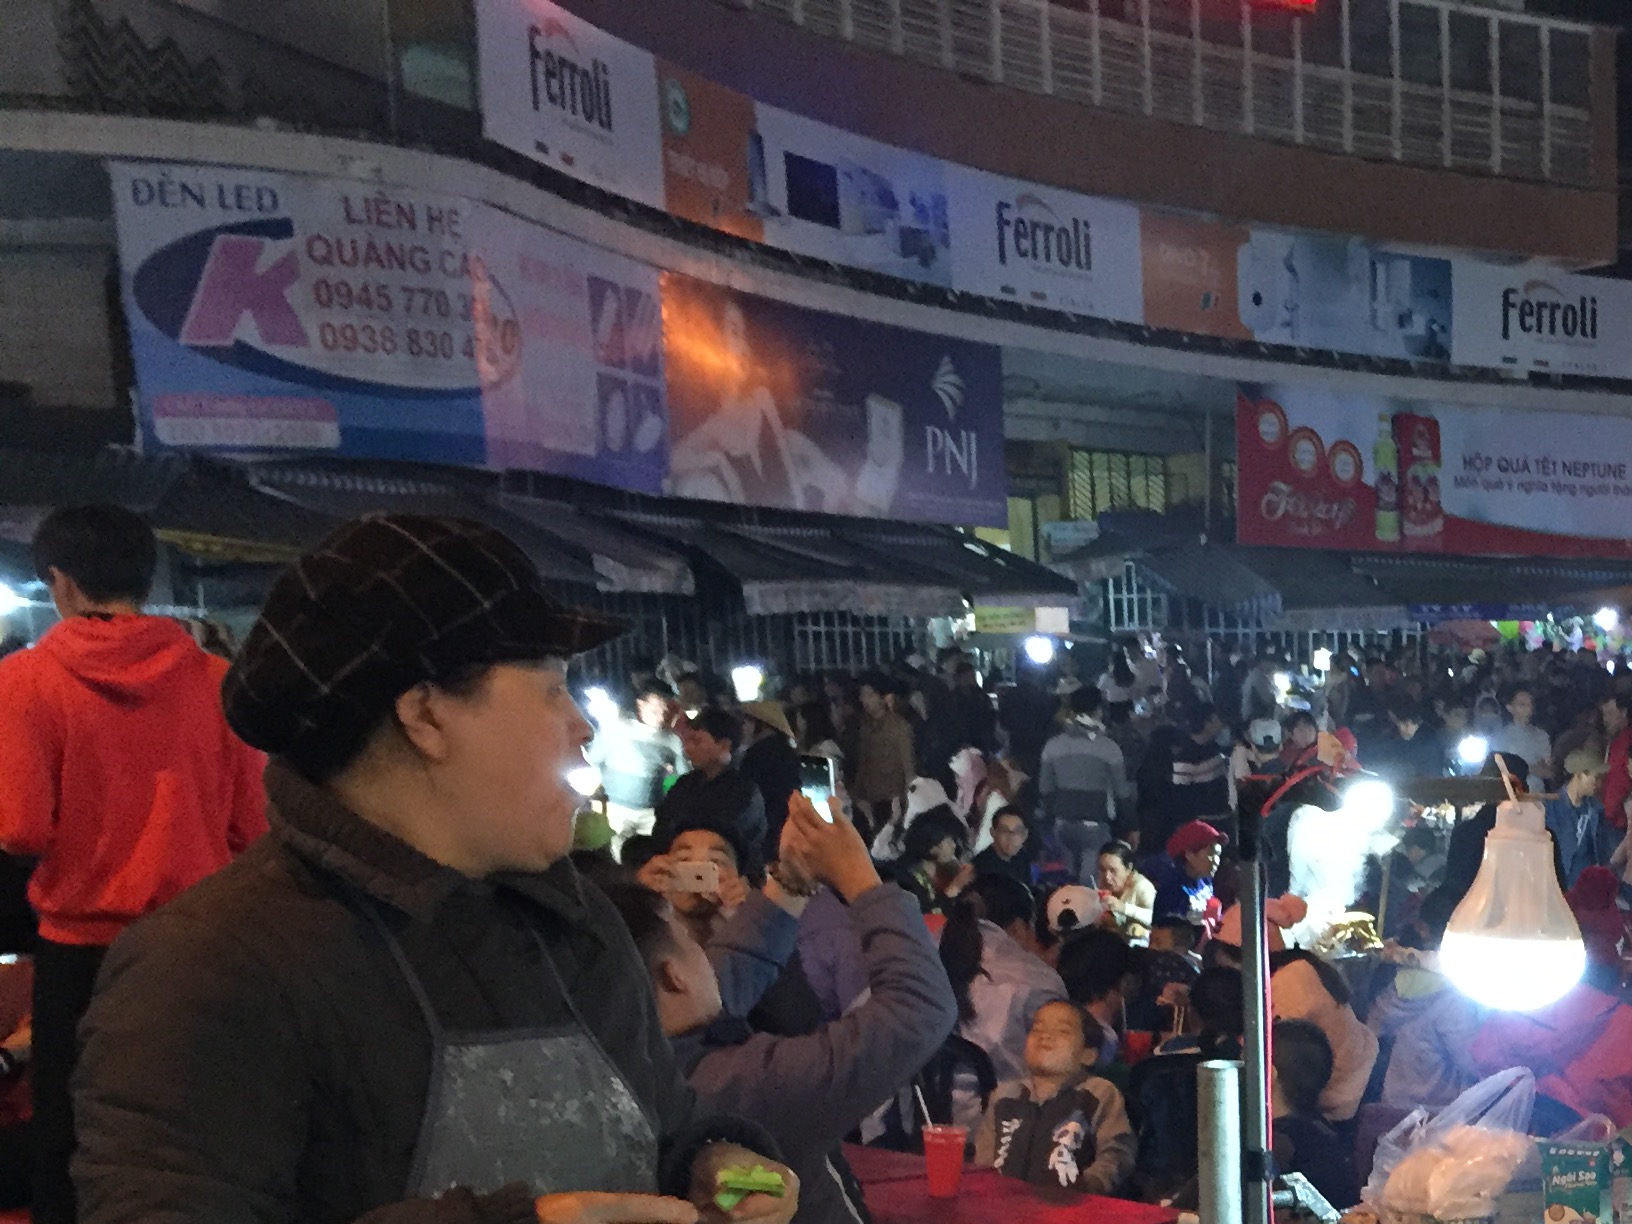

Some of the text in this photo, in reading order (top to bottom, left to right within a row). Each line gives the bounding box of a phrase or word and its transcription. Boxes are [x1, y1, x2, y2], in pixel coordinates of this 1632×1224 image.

[528, 25, 613, 132] Ferroli
[217, 183, 280, 212] LED
[996, 200, 1092, 271] Ferroli
[1502, 287, 1598, 341] Ferroli
[925, 425, 978, 490] PNJ
[1562, 460, 1627, 480] NEPTUNE
